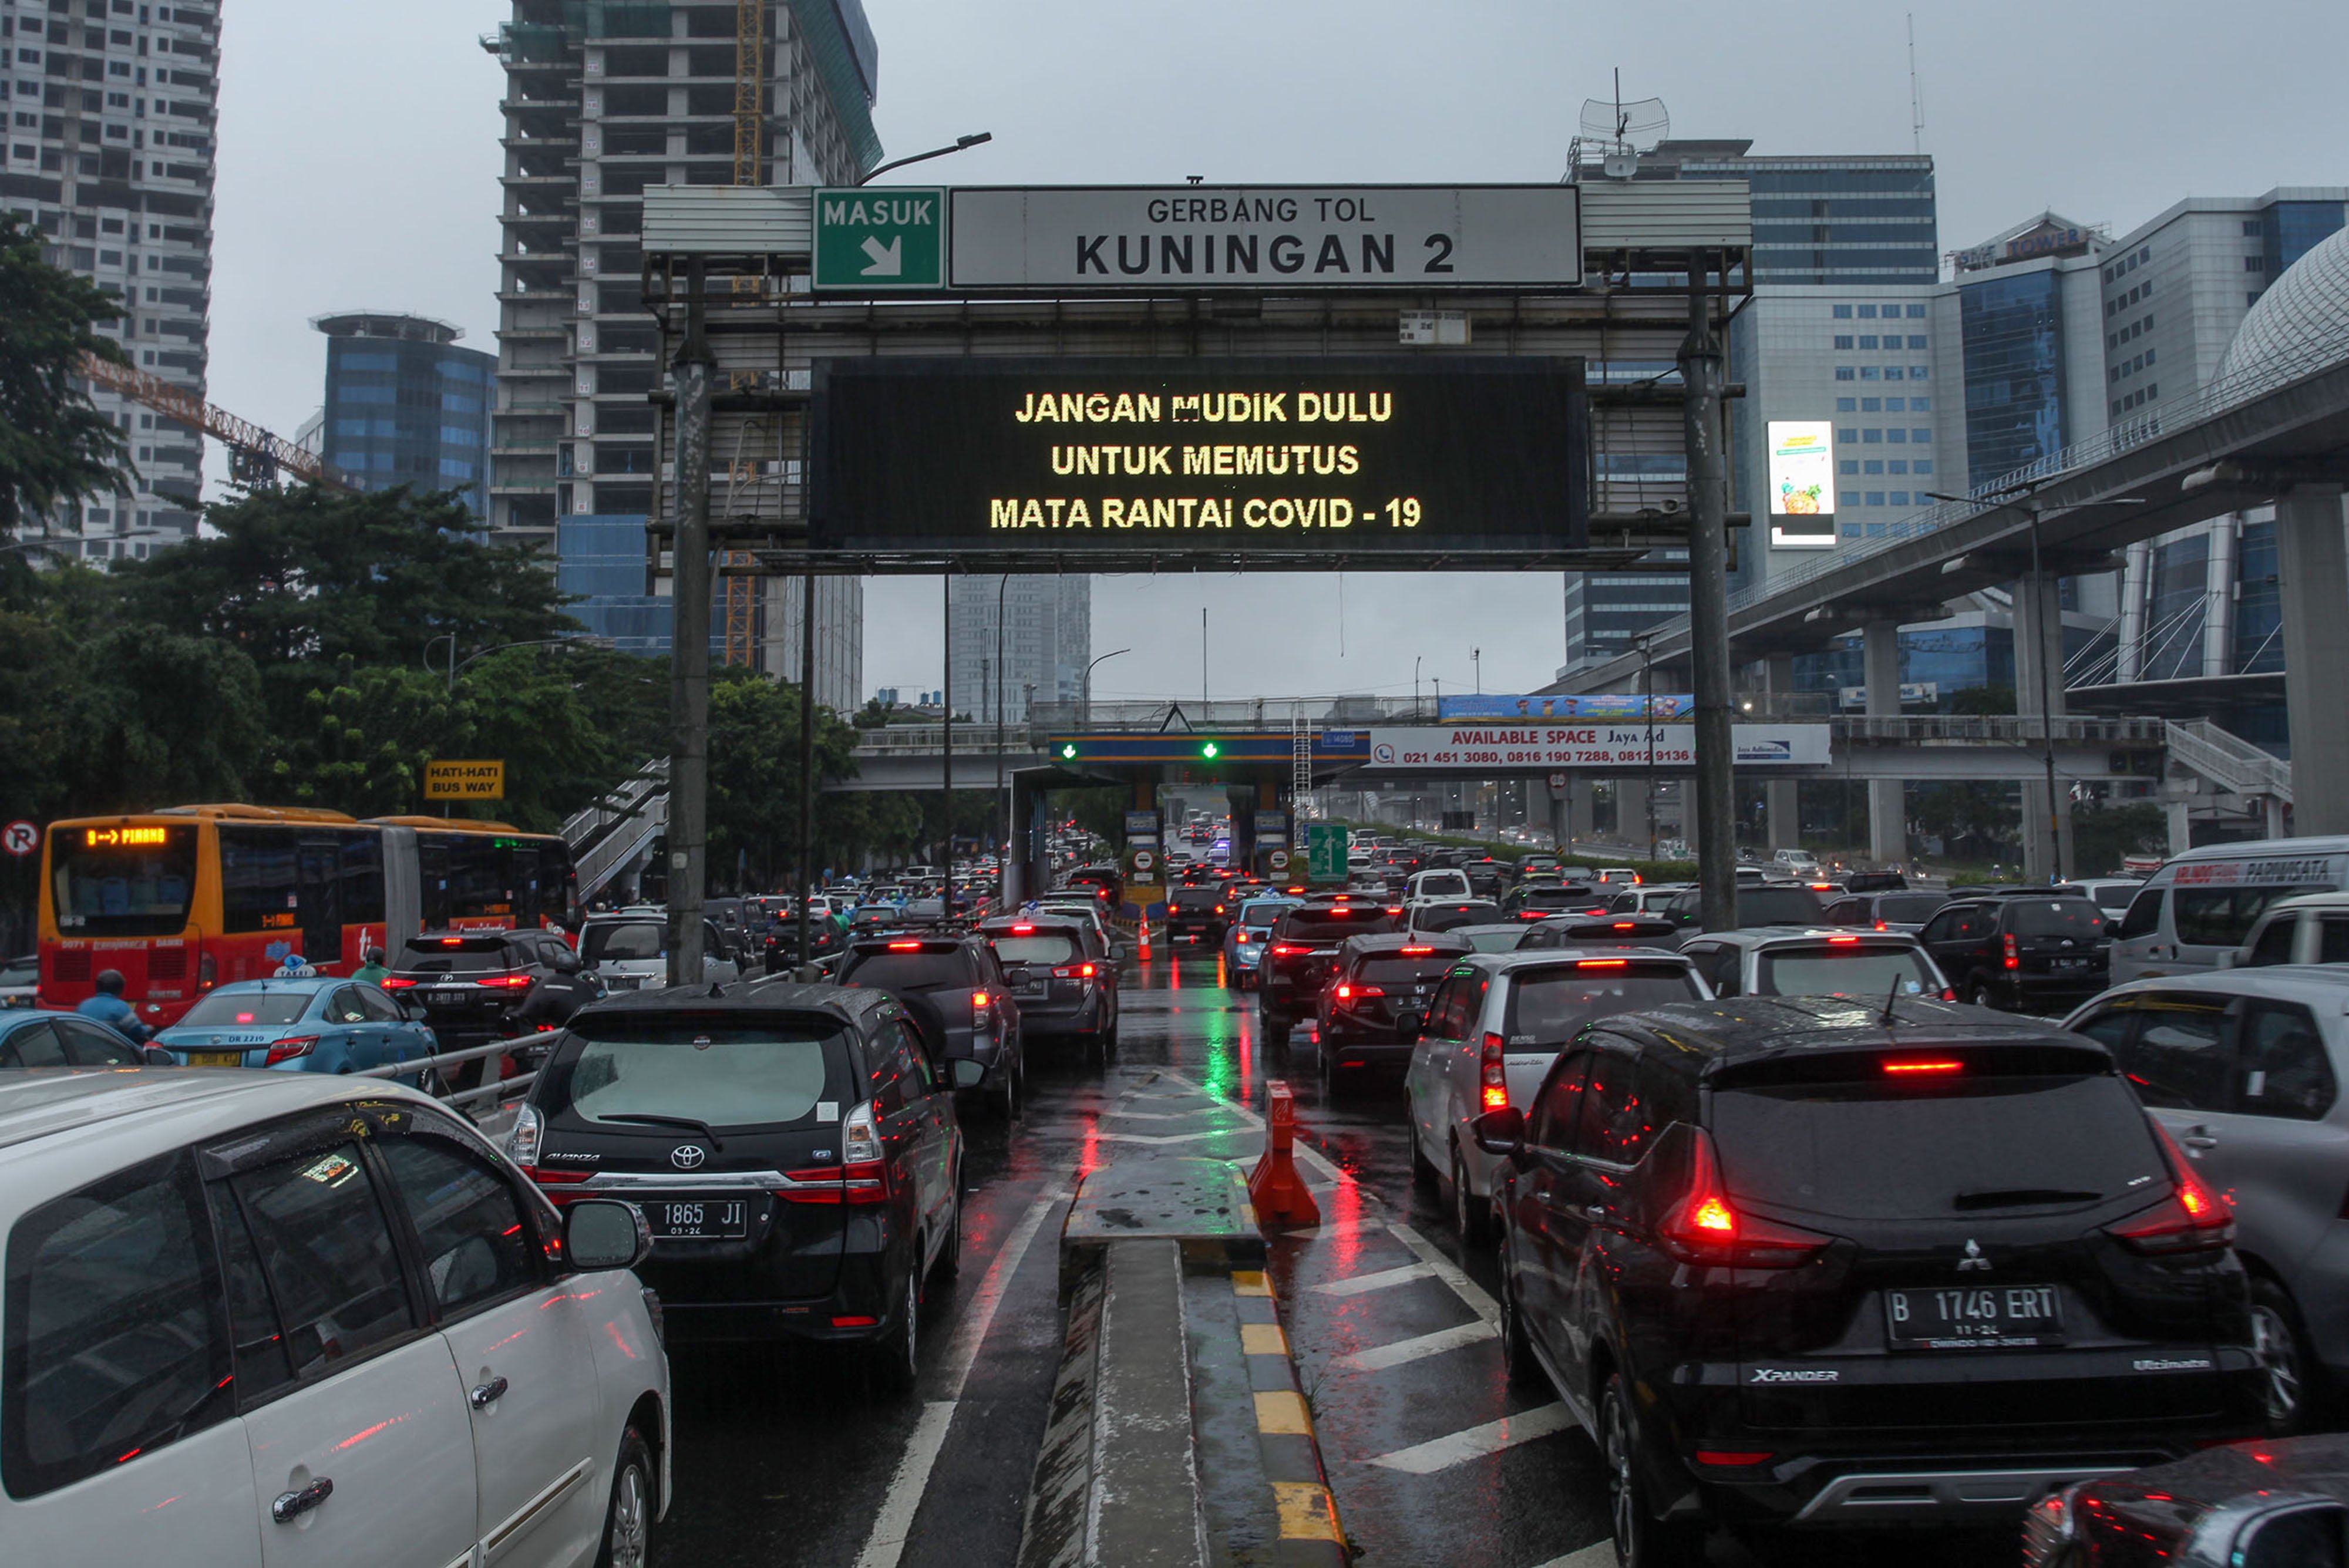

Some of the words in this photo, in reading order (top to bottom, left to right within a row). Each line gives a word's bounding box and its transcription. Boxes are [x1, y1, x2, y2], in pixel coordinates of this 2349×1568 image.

[824, 200, 931, 225] MASUK
[1147, 200, 1297, 223] GERBANG
[1314, 197, 1375, 222] TOL
[2007, 228, 2079, 255] TOWER
[1076, 234, 1395, 276] KUNINGAN
[1423, 233, 1454, 273] 2
[1015, 393, 1160, 422] JANGAN
[1172, 392, 1287, 422] MUDIK
[1298, 392, 1392, 422] DULU
[1052, 445, 1173, 475] UNTUK
[1183, 445, 1359, 475] MEMUTUS
[991, 499, 1092, 528] MATA
[1102, 499, 1232, 528] RANTAI
[1243, 498, 1354, 528] COVID
[1385, 497, 1421, 527] 19
[1452, 730, 1539, 745] AVAILABLE
[1546, 729, 1597, 745] SPACE
[1404, 752, 1428, 763] 021
[1433, 752, 1458, 763] 451
[1464, 751, 1503, 764] 3080,
[1507, 751, 1542, 763] 0816
[1546, 751, 1571, 762] 190
[1576, 750, 1614, 763] 7288,
[1618, 750, 1652, 762] 0812
[1655, 749, 1690, 761] 9136
[430, 767, 498, 778] HATI-HATI
[432, 782, 460, 793] BUS
[465, 782, 495, 792] WAY
[544, 1153, 601, 1162] AVANZA
[664, 1203, 705, 1224] 1865
[721, 1203, 741, 1224] JI
[1892, 1293, 1910, 1322] B
[1935, 1291, 1997, 1320] 1746
[2005, 1288, 2054, 1318] ERT
[1749, 1369, 1840, 1382] XPANDER
[2133, 1360, 2211, 1371] Ultimate
